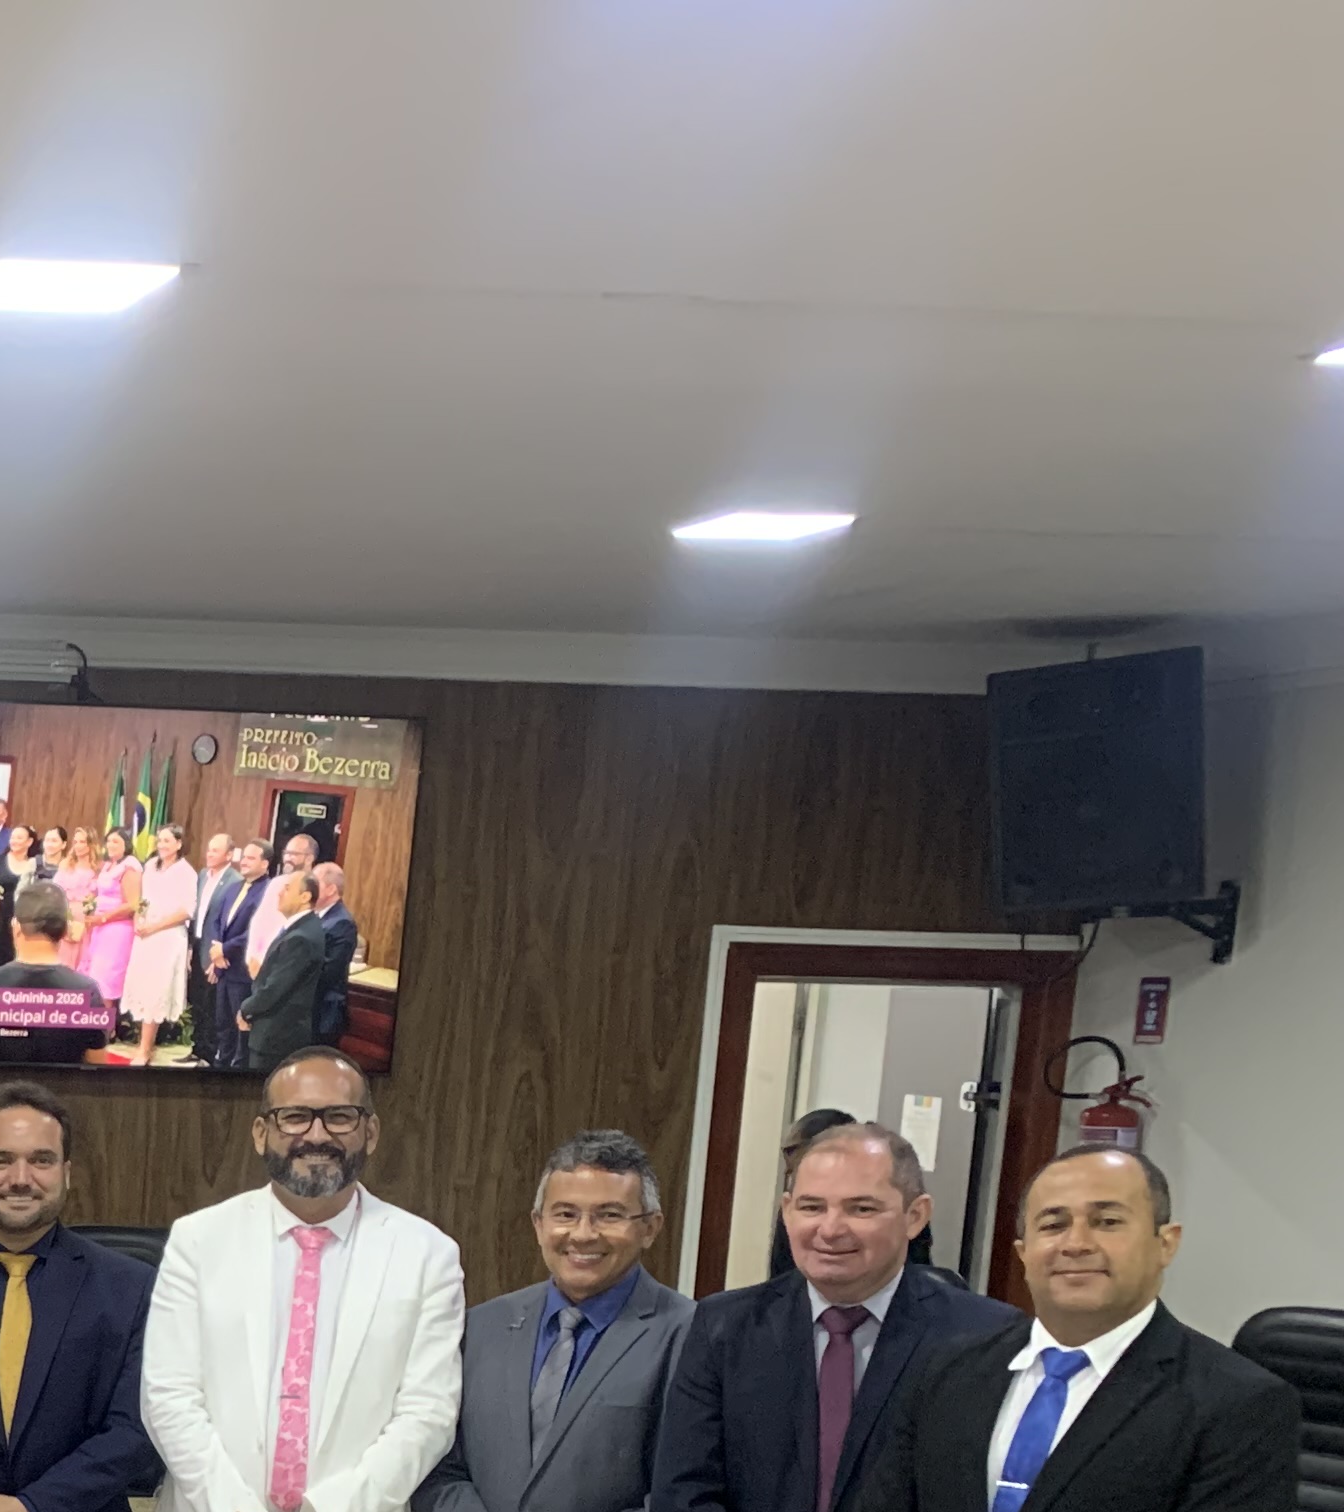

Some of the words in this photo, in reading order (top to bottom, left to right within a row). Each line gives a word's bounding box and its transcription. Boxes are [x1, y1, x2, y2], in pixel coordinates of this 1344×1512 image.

[242, 727, 318, 746] PREFEITO
[239, 744, 299, 772] Inácio
[303, 747, 391, 780] Bezerra
[2, 991, 54, 1005] Quininha
[55, 992, 85, 1005] 2026
[48, 1009, 68, 1024] de
[70, 1010, 110, 1025] Caicó
[0, 1028, 29, 1037] Bezerra
